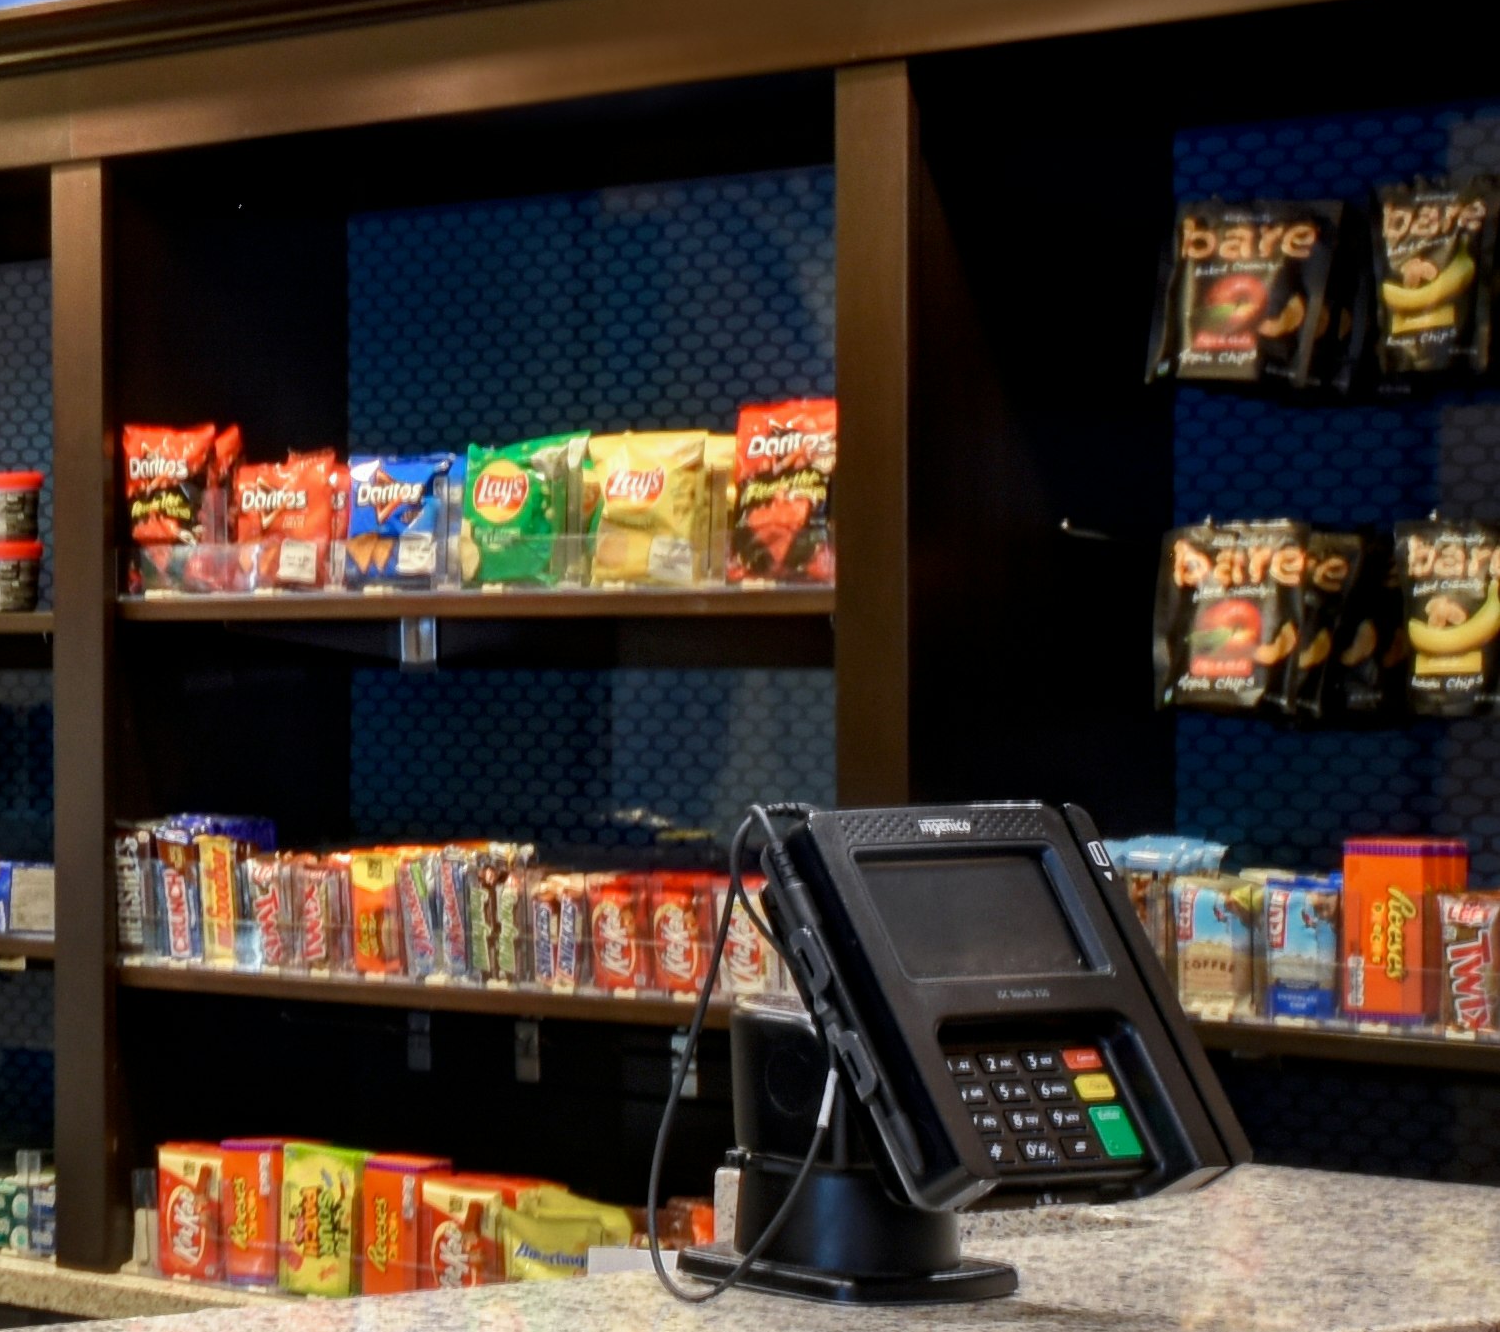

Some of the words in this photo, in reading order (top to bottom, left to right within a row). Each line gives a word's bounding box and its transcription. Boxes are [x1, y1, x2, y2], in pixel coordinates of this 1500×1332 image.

[1383, 196, 1487, 238] bare
[1182, 217, 1318, 259] bare
[747, 433, 836, 459] Doritos
[129, 457, 189, 480] Doritos
[357, 481, 424, 507] Doritos
[478, 471, 525, 507] Lay's
[608, 465, 665, 500] Lay's
[241, 488, 308, 513] Doritos
[1174, 538, 1306, 588] bare
[918, 818, 971, 838] ingenico
[165, 871, 191, 955] CRUNCH
[1446, 929, 1493, 1030] TWIX
[987, 1057, 996, 1072] 2
[1027, 1054, 1037, 1070] 3
[999, 1084, 1009, 1100] 5
[1040, 1082, 1050, 1098] 6
[1012, 1113, 1023, 1129] 8
[1053, 1109, 1063, 1126] 9
